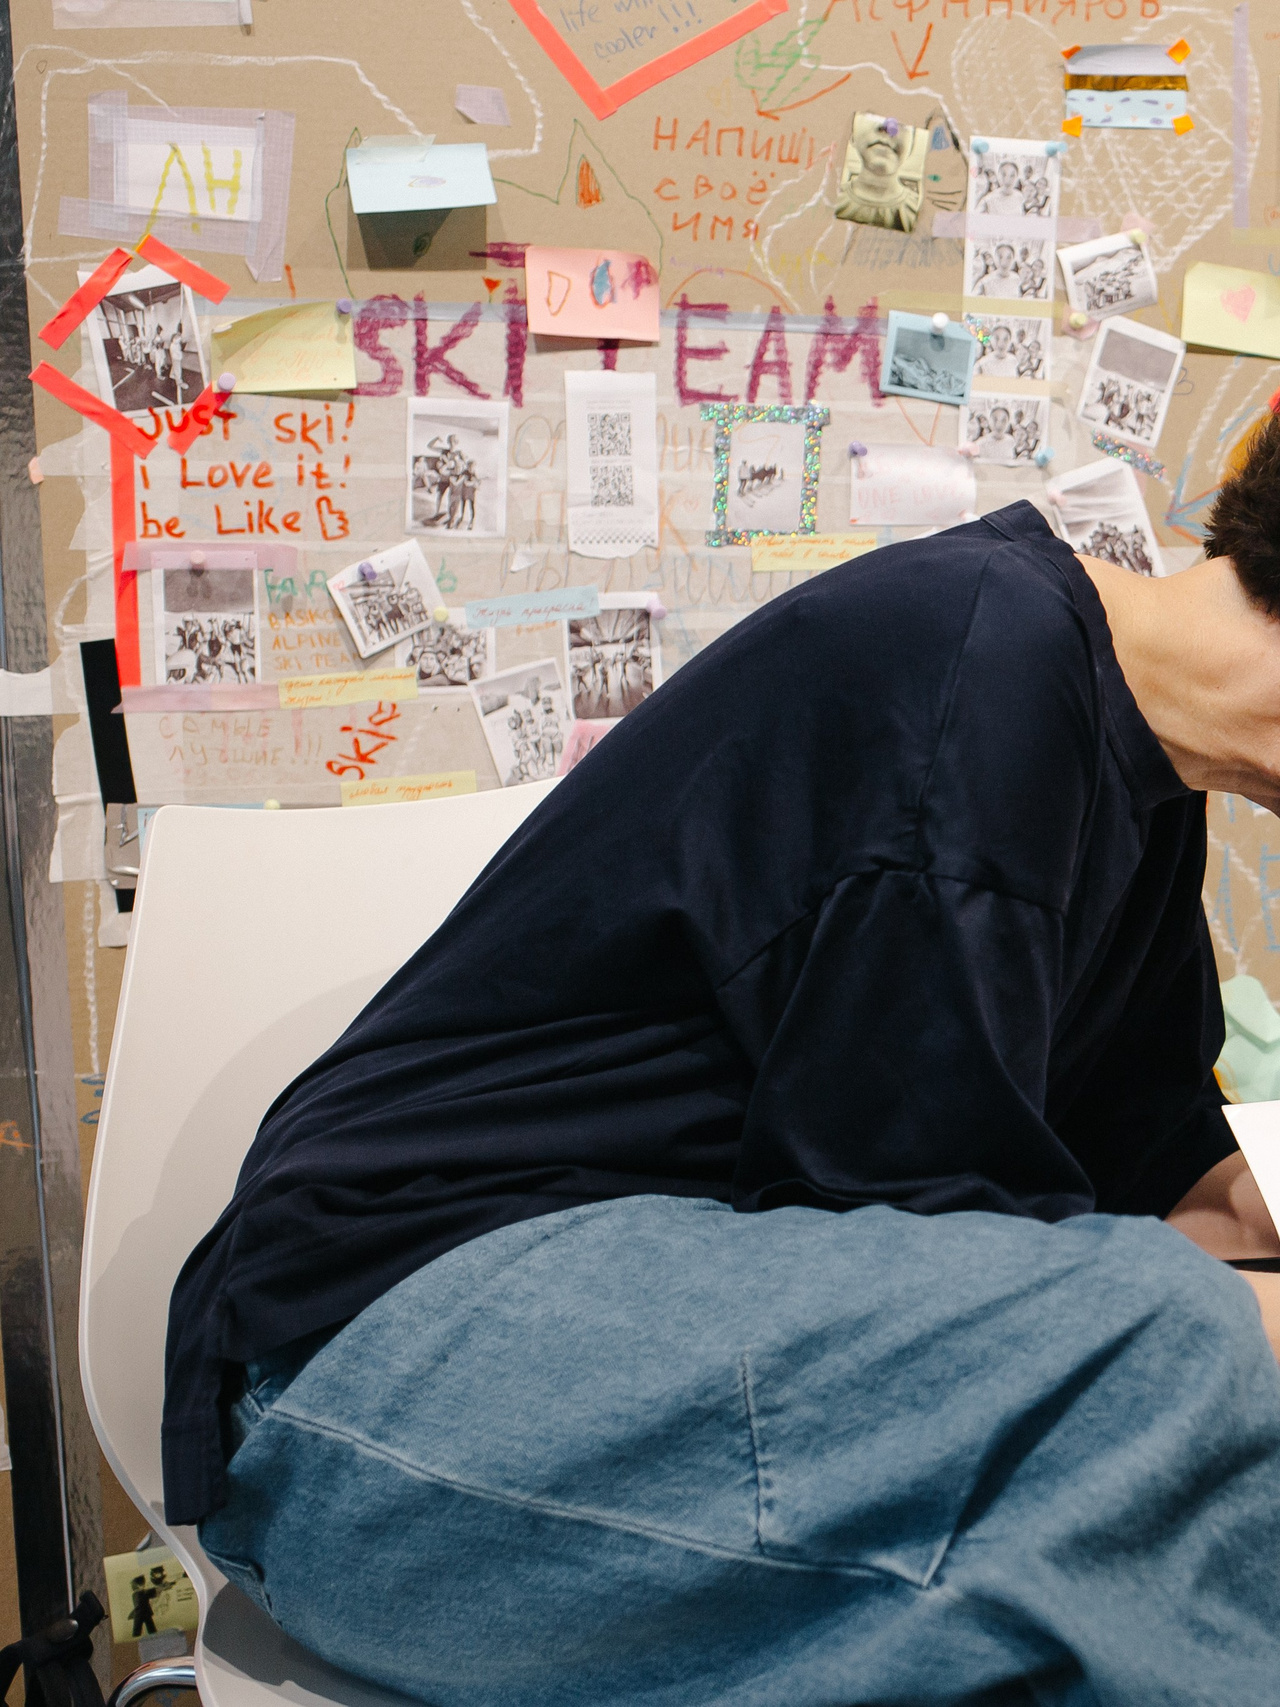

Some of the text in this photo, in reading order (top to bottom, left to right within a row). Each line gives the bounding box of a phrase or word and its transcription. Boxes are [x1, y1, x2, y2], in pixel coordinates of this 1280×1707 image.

[671, 212, 759, 242] ИМЯ
[140, 501, 186, 538] be
[272, 633, 341, 651] ALPINE
[274, 655, 302, 671] SKI
